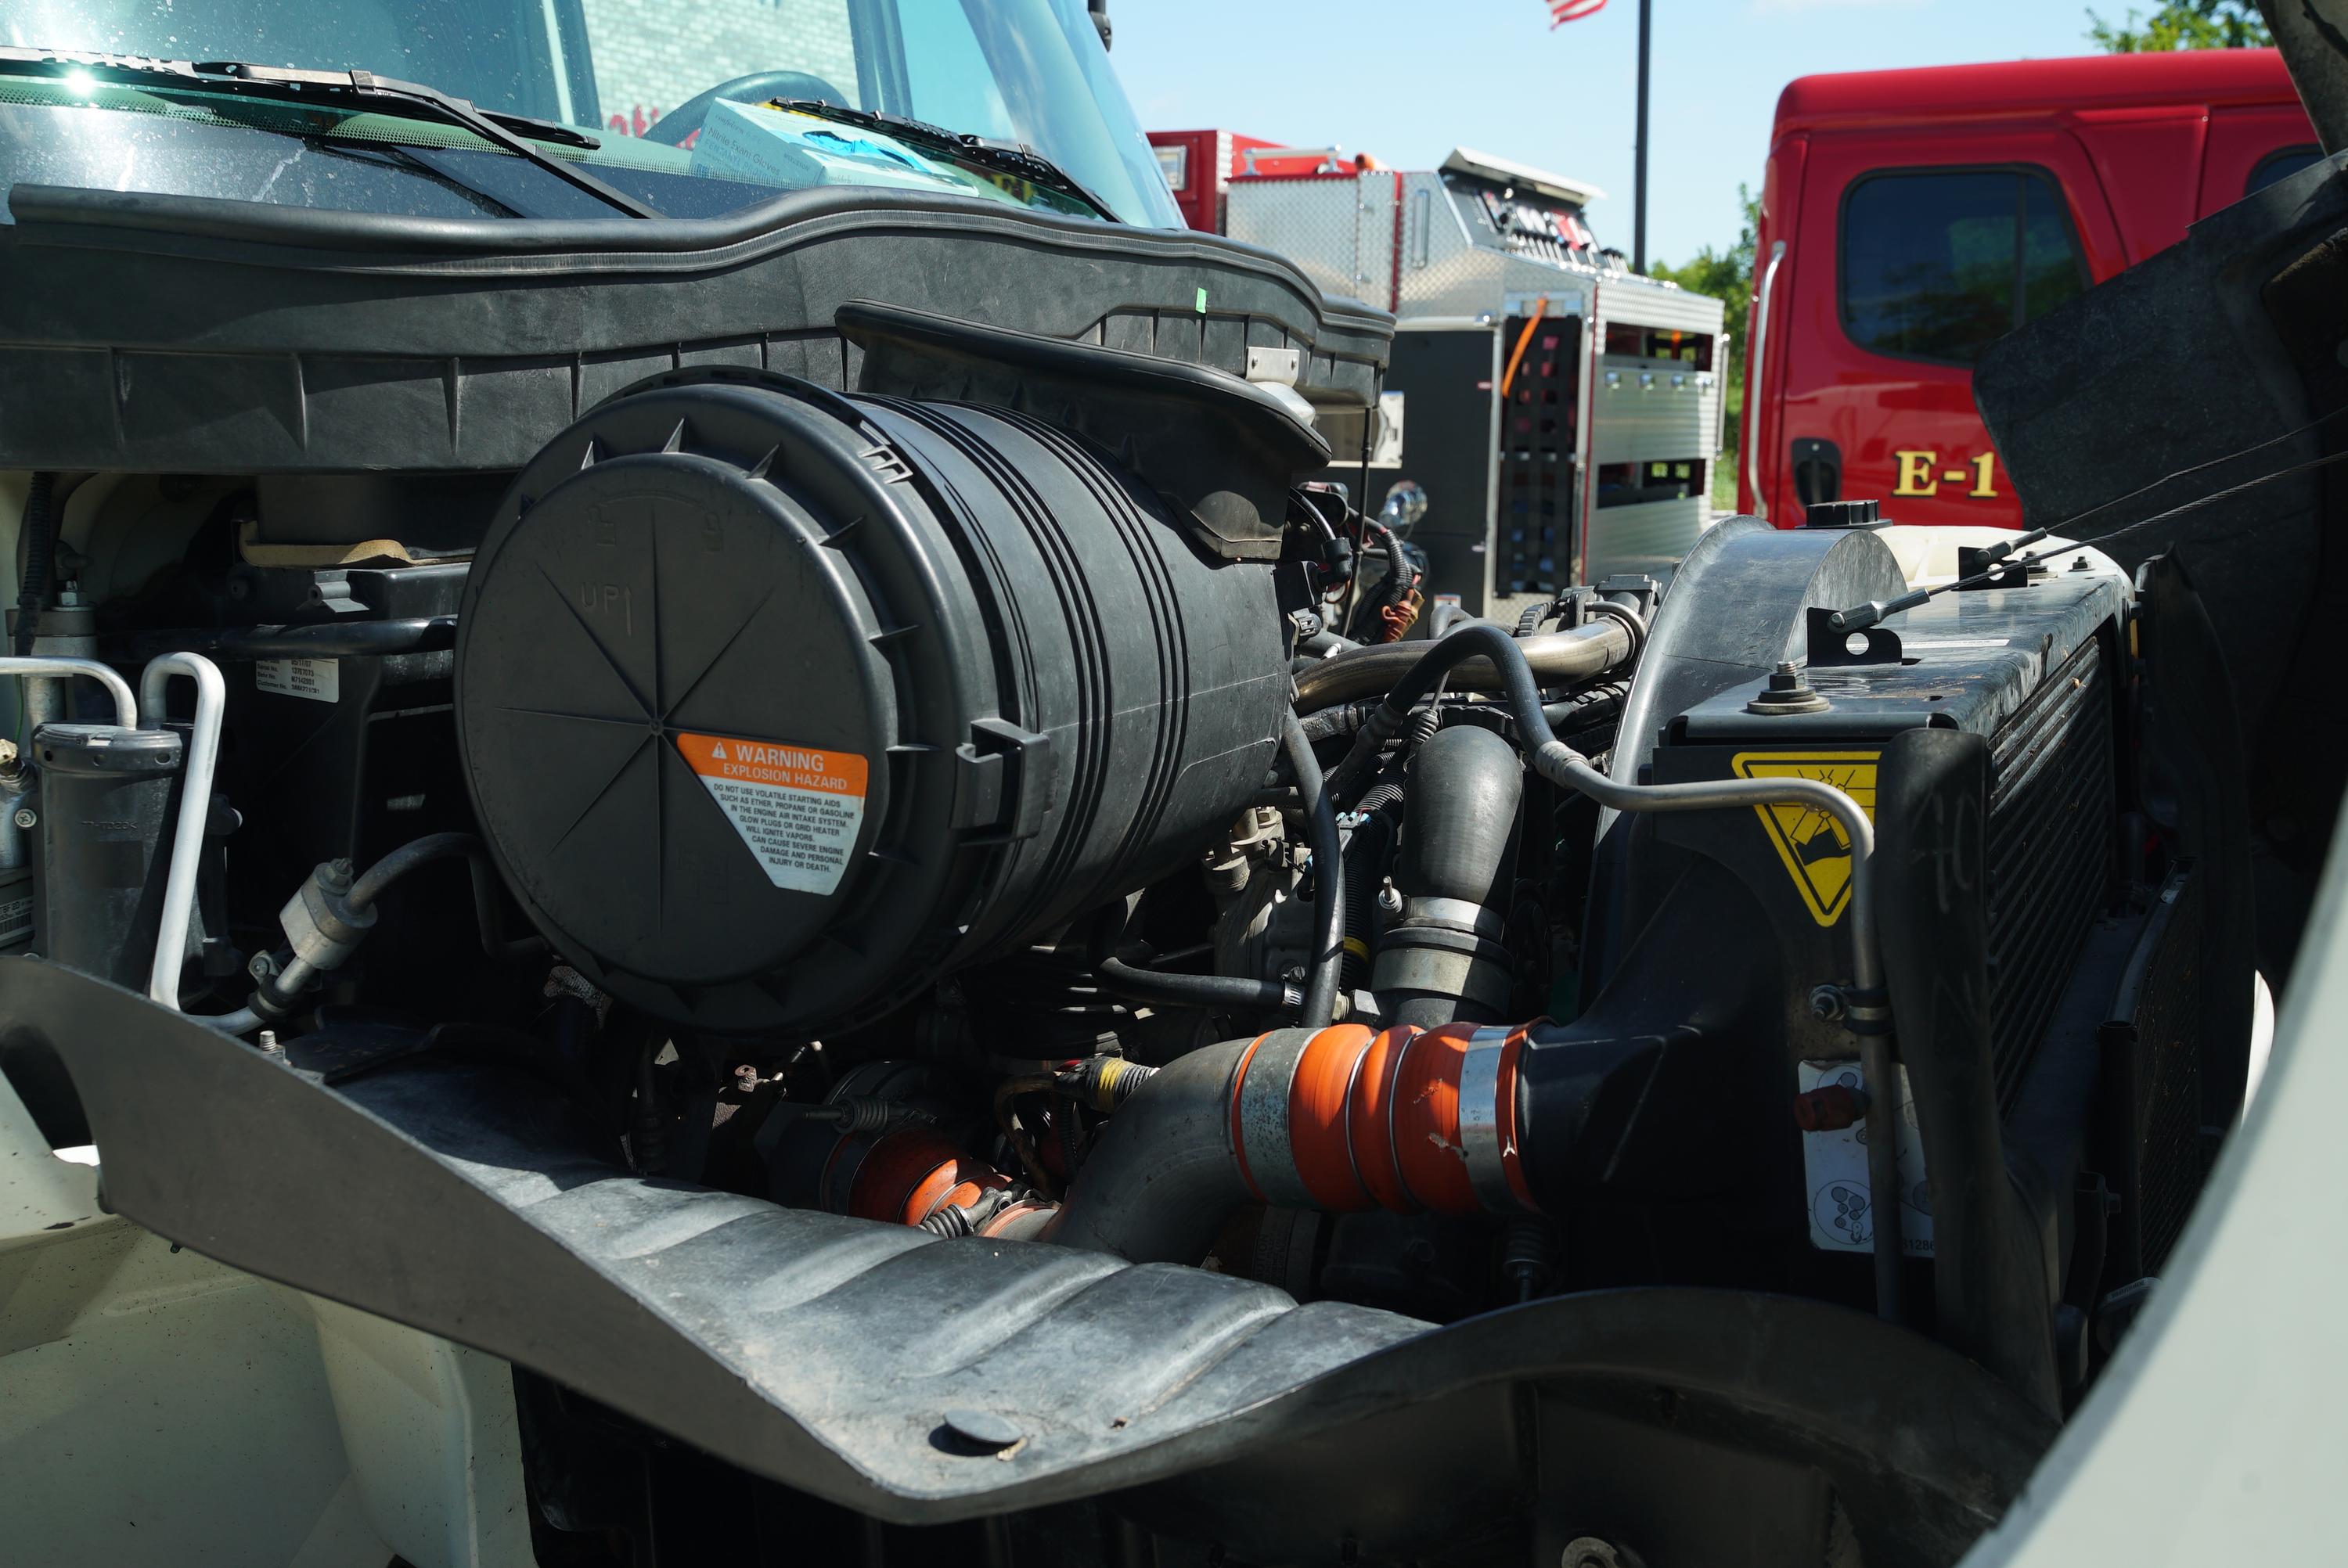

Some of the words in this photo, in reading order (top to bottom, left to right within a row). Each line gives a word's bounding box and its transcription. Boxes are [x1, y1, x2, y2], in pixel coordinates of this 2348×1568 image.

[732, 139, 752, 159] Exam
[753, 153, 781, 177] Gloves
[1892, 450, 1998, 497] E-1
[579, 582, 620, 614] UP
[736, 745, 824, 771] WARNING
[724, 763, 790, 783] EXPLOSION
[795, 774, 847, 790] HAZARD
[720, 794, 738, 803] SUCH
[751, 799, 773, 808] ETHER,
[776, 802, 805, 812] PROPANE
[820, 808, 854, 819] GASOLINE
[726, 785, 739, 793] NOT
[755, 789, 786, 800] VOLATILE
[789, 794, 822, 806] STARTING
[824, 799, 841, 807] AIDS
[740, 806, 751, 815] THE
[754, 808, 777, 818] ENGINE
[792, 813, 816, 824] INTAKE
[818, 817, 848, 828] SYSTEM.
[740, 815, 758, 825] GLOW
[761, 818, 782, 828] PLUGS
[795, 823, 811, 832] GRID
[813, 825, 840, 836] HEATER
[746, 825, 760, 834] WILL
[763, 828, 783, 837] IGNITE
[786, 832, 815, 842] VAPORS.
[752, 836, 766, 844] CAN
[768, 838, 790, 847] CAUSE
[792, 842, 817, 852] SEVERE
[819, 845, 844, 856] ENGINE
[761, 847, 789, 857] DAMAGE
[791, 851, 805, 859] AND
[808, 853, 844, 865] PERSONAL
[769, 858, 792, 867] INJURY
[806, 862, 831, 872] DEATH.
